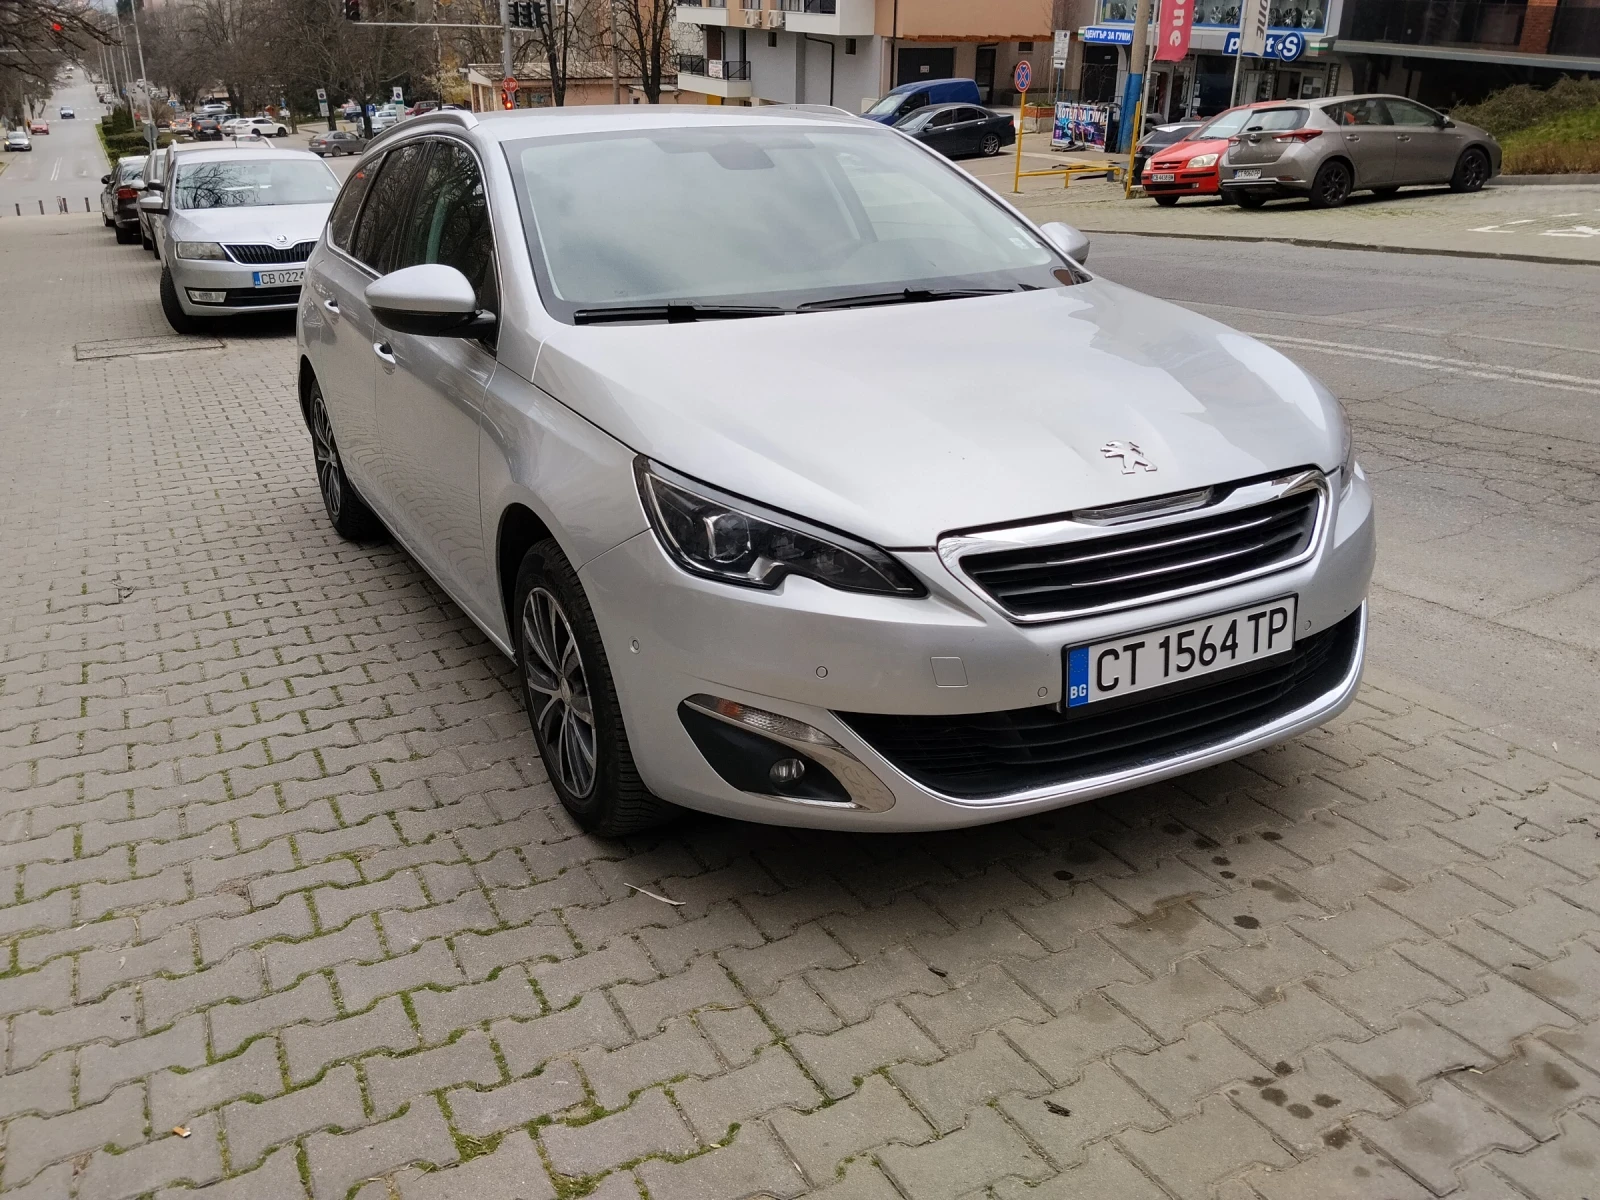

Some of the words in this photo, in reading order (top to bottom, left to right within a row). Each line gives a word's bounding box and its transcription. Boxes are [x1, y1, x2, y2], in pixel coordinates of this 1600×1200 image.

[1169, 0, 1186, 47] ne
[1085, 29, 1107, 39] ЦЕНТЪР
[1107, 31, 1115, 40] ЗА
[1115, 32, 1131, 41] ГУМИ
[261, 273, 276, 285] CB
[1096, 641, 1146, 692] CT
[1159, 619, 1239, 678] 1564
[1247, 607, 1288, 654] TP
[1070, 683, 1087, 699] BG
